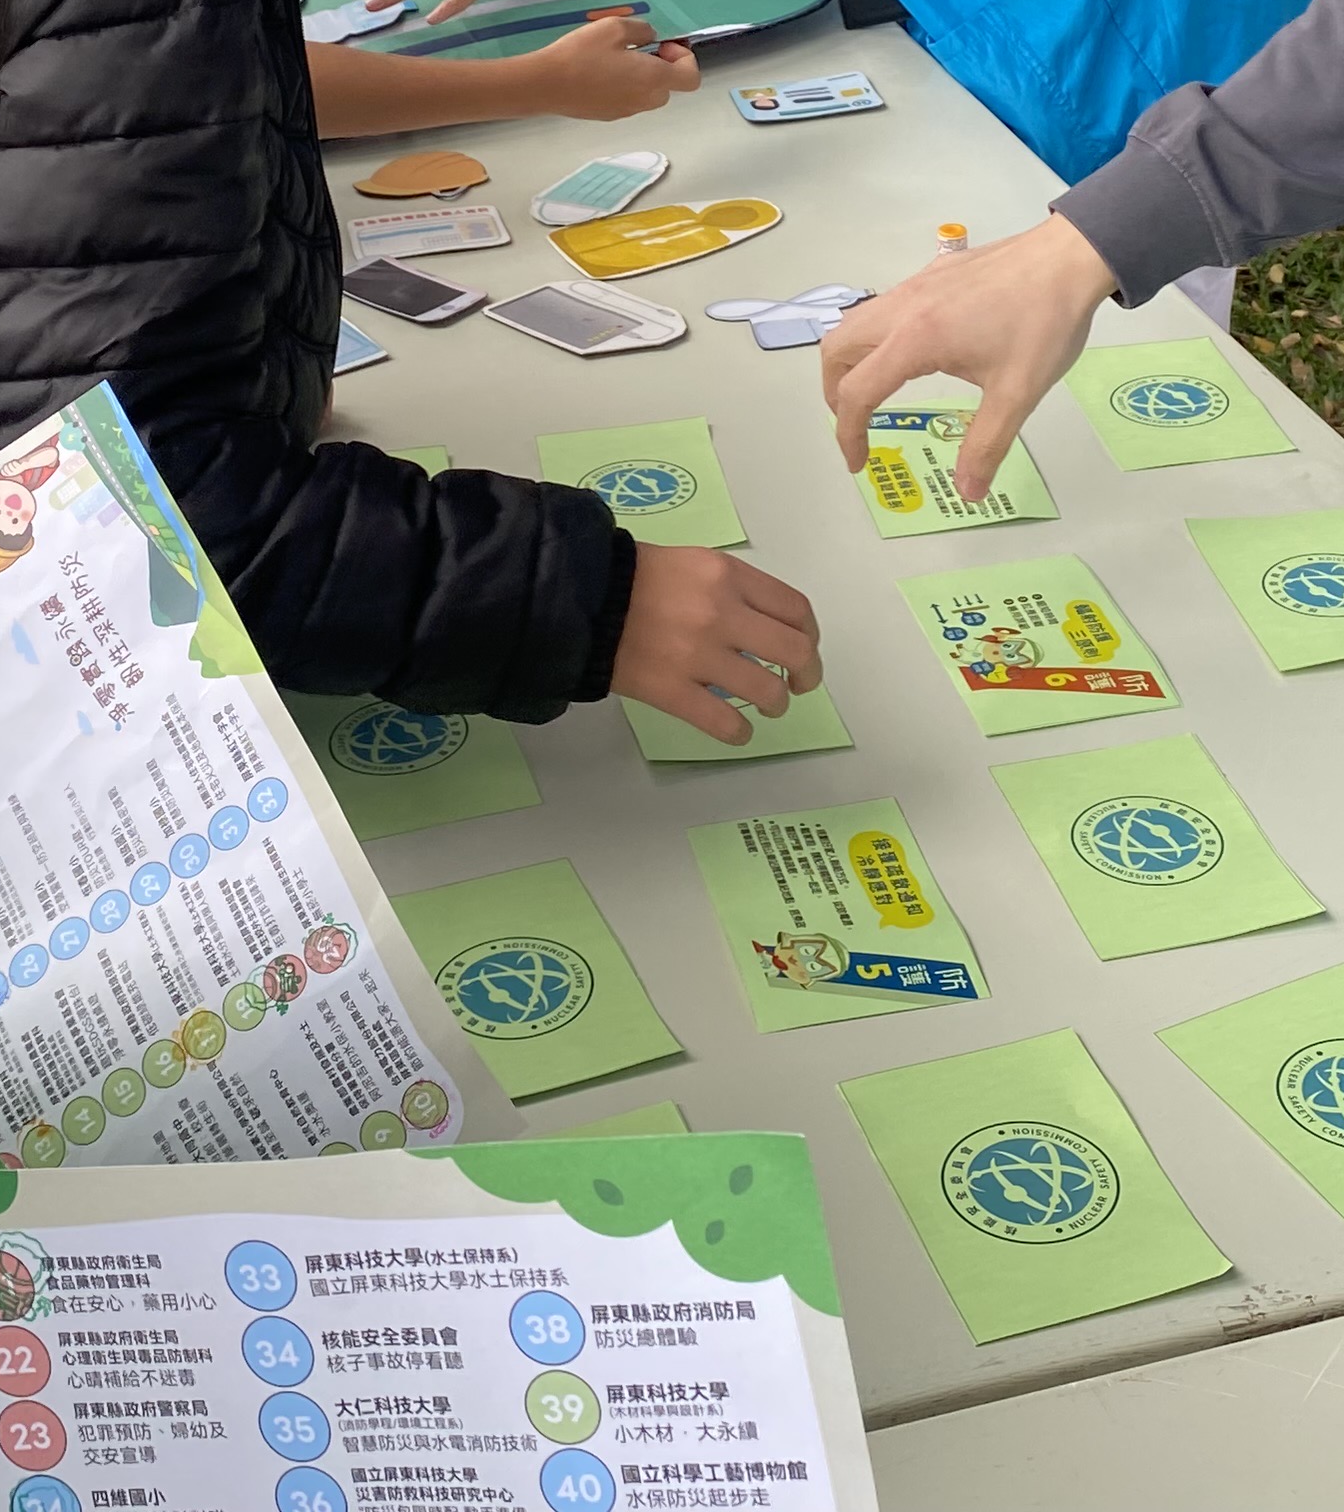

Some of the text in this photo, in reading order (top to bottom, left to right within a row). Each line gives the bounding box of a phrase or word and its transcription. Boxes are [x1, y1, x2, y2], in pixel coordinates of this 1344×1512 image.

[57, 547, 146, 689] 韌性深耕防災
[1073, 603, 1113, 642] 輻射防護
[1068, 629, 1100, 658] 三原則
[38, 591, 136, 728] 淨零實踐永續
[164, 691, 226, 802] 住宅火災及地震基本保險
[210, 709, 254, 782] 屏東縣紅十字會
[222, 700, 265, 774] 屏東縣紅十字會
[255, 785, 278, 815] 32
[218, 816, 239, 841] 31
[1083, 804, 1116, 827] NUCLEAR
[177, 841, 201, 872] 30
[1096, 858, 1162, 880] COMMISSION
[138, 869, 161, 899] 29
[854, 854, 895, 906] 冷靜應對
[869, 837, 924, 916] 接獲疏散通知
[98, 896, 121, 926] 28
[58, 925, 80, 952] 27
[18, 951, 40, 980] 26
[503, 942, 585, 1026] NUCLEAR SAFETY COMMISSION
[357, 966, 424, 1072] 節約能源大家一起來
[192, 1020, 217, 1049] 17
[339, 989, 402, 1087] 台灣電力股份有限公司
[153, 1049, 176, 1076] 16
[315, 996, 383, 1102] 阿泥吉的水保小教室
[1287, 1055, 1313, 1089] NUCLEAR
[113, 1077, 137, 1106] 15
[412, 1089, 437, 1118] 10
[72, 1105, 97, 1135] 14
[1288, 1095, 1316, 1124] SAFETY
[373, 1123, 392, 1145] 9
[33, 1135, 56, 1163] 13
[1012, 1128, 1110, 1230] NUCLEAR SAFETY COMMISSION
[42, 1254, 162, 1271] 屏東縣政府衛生局
[305, 1248, 518, 1274] 屏東科技大學(水土保持系)
[47, 1274, 151, 1291] 食品藥物管理科
[239, 1265, 281, 1292] 33
[309, 1268, 569, 1297] 國立屏東科技大學水土保持系
[591, 1301, 756, 1324] 屏東縣政府消防局
[58, 1330, 179, 1347] 屏東縣政府衛生局
[321, 1327, 458, 1350] 核能安全委員會
[525, 1315, 570, 1344] 38
[595, 1327, 698, 1349] 防災總體驗
[63, 1348, 213, 1366] 心理衛生與毒品防制科
[256, 1340, 300, 1368] 34
[327, 1352, 463, 1374] 核子事故停看聽
[68, 1369, 195, 1389] 心晴補給不迷毒
[607, 1382, 730, 1404] 屏東科技大學
[74, 1400, 208, 1419] 屏東縣政府警察局
[335, 1396, 452, 1417] 大仁科技大學
[541, 1394, 584, 1424] 39
[10, 1422, 51, 1451] 23
[78, 1422, 228, 1442] 犯罪預防、婦幼及
[273, 1416, 316, 1443] 35
[342, 1434, 537, 1453] 智慧防災與水電消防技術
[83, 1446, 157, 1466] 交安宣導
[351, 1467, 479, 1483] 國立屏東科技大學
[621, 1462, 808, 1484] 國立科學工藝博物館
[92, 1488, 166, 1507] 四維國小
[290, 1492, 333, 1512] 36
[356, 1487, 514, 1504] 災害防救科技研究中心
[557, 1474, 601, 1502] 40
[626, 1488, 771, 1508] 水保防災起步走
